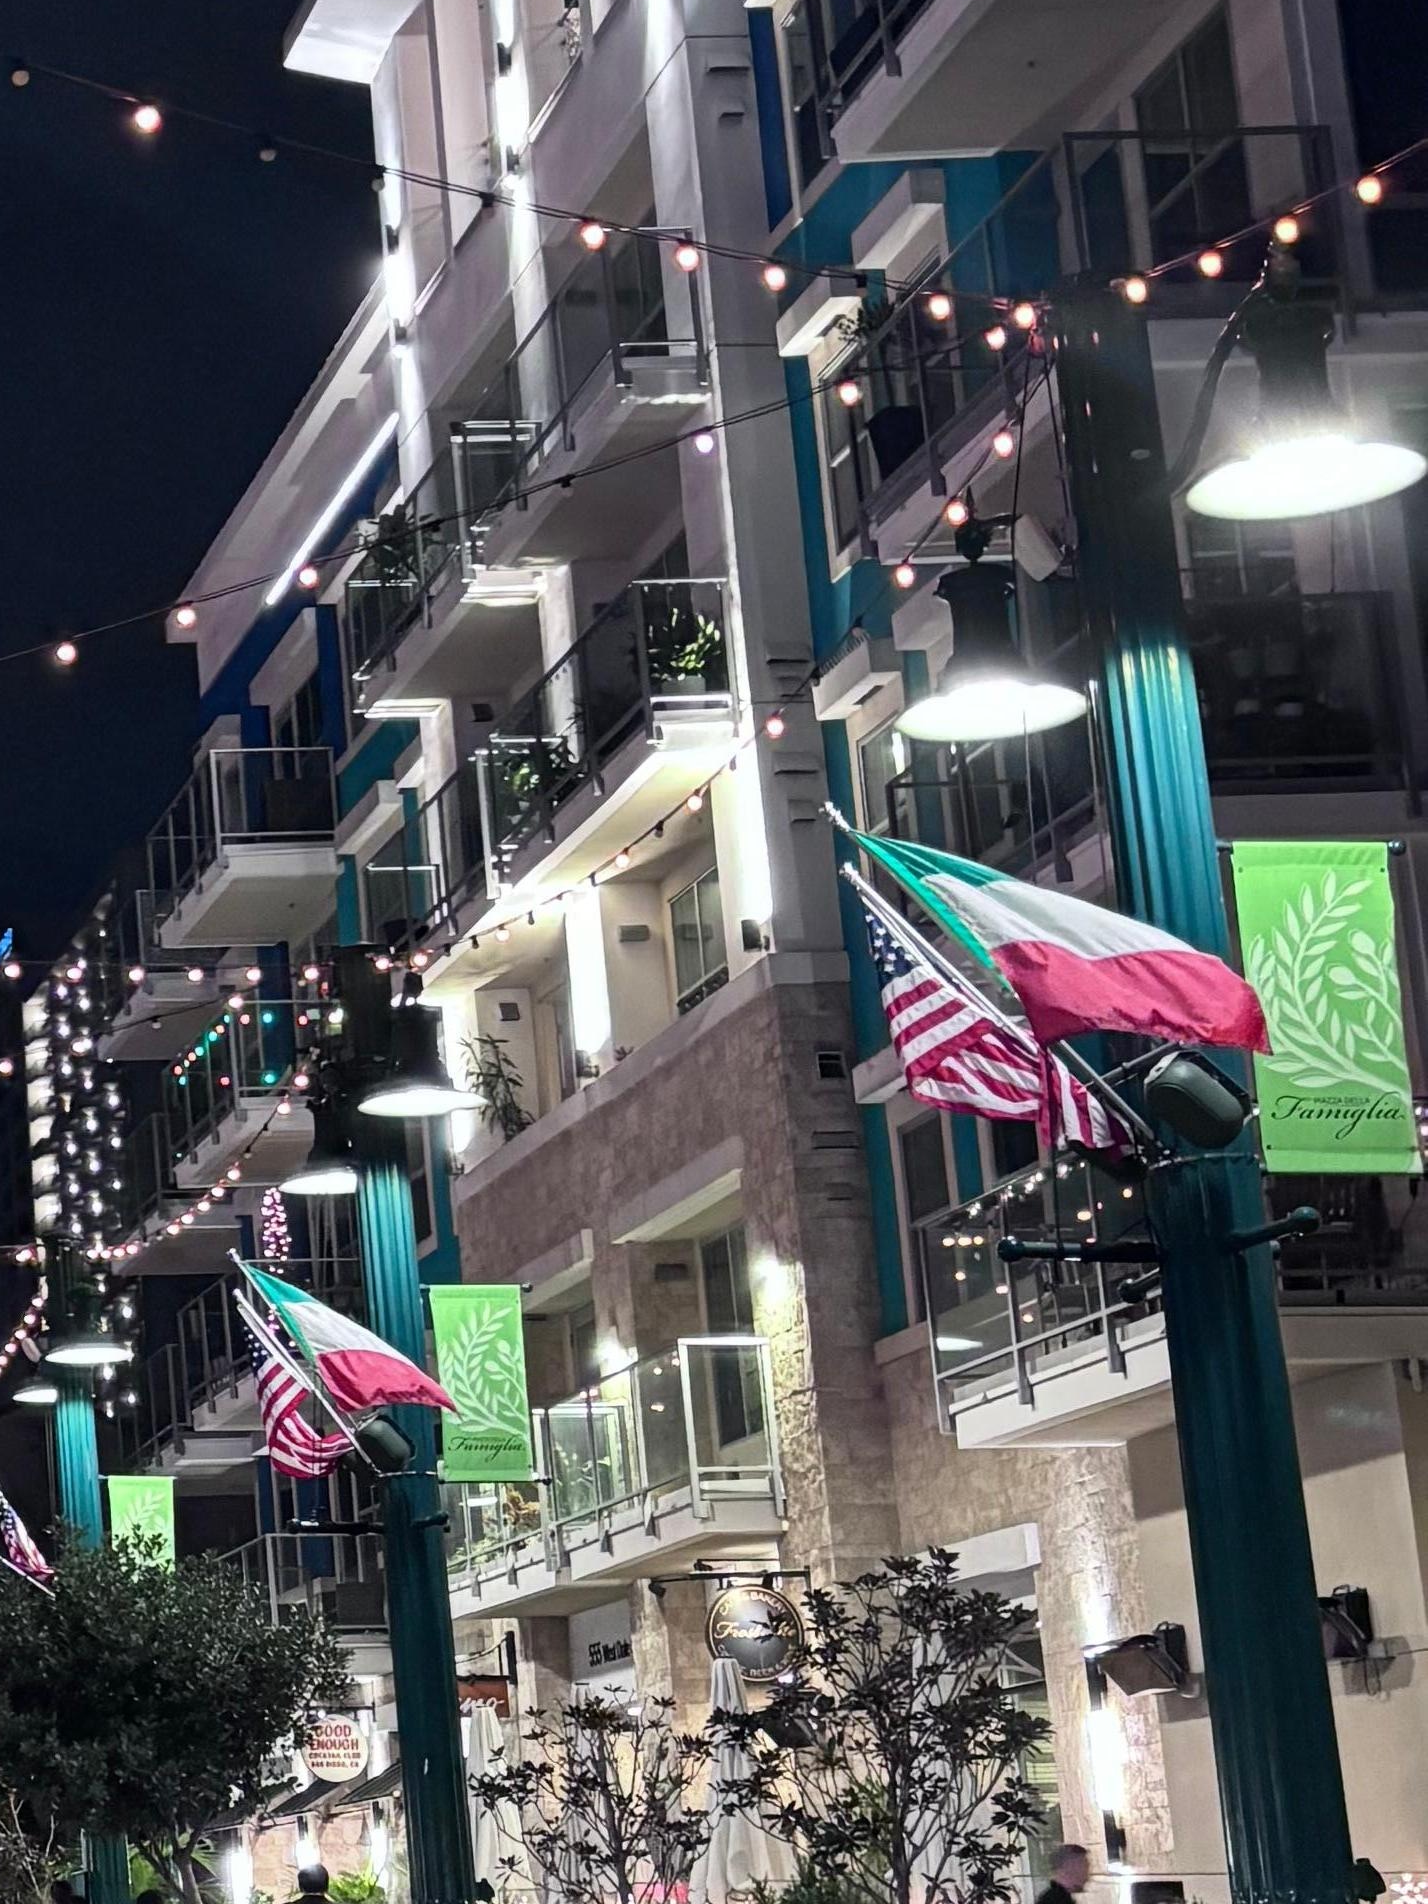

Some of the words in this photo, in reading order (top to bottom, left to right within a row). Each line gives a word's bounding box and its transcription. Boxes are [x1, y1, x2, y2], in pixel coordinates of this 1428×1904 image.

[1270, 1091, 1407, 1140] Famiglia
[315, 1725, 352, 1737] GOOD
[310, 1739, 358, 1750] ENOUGH
